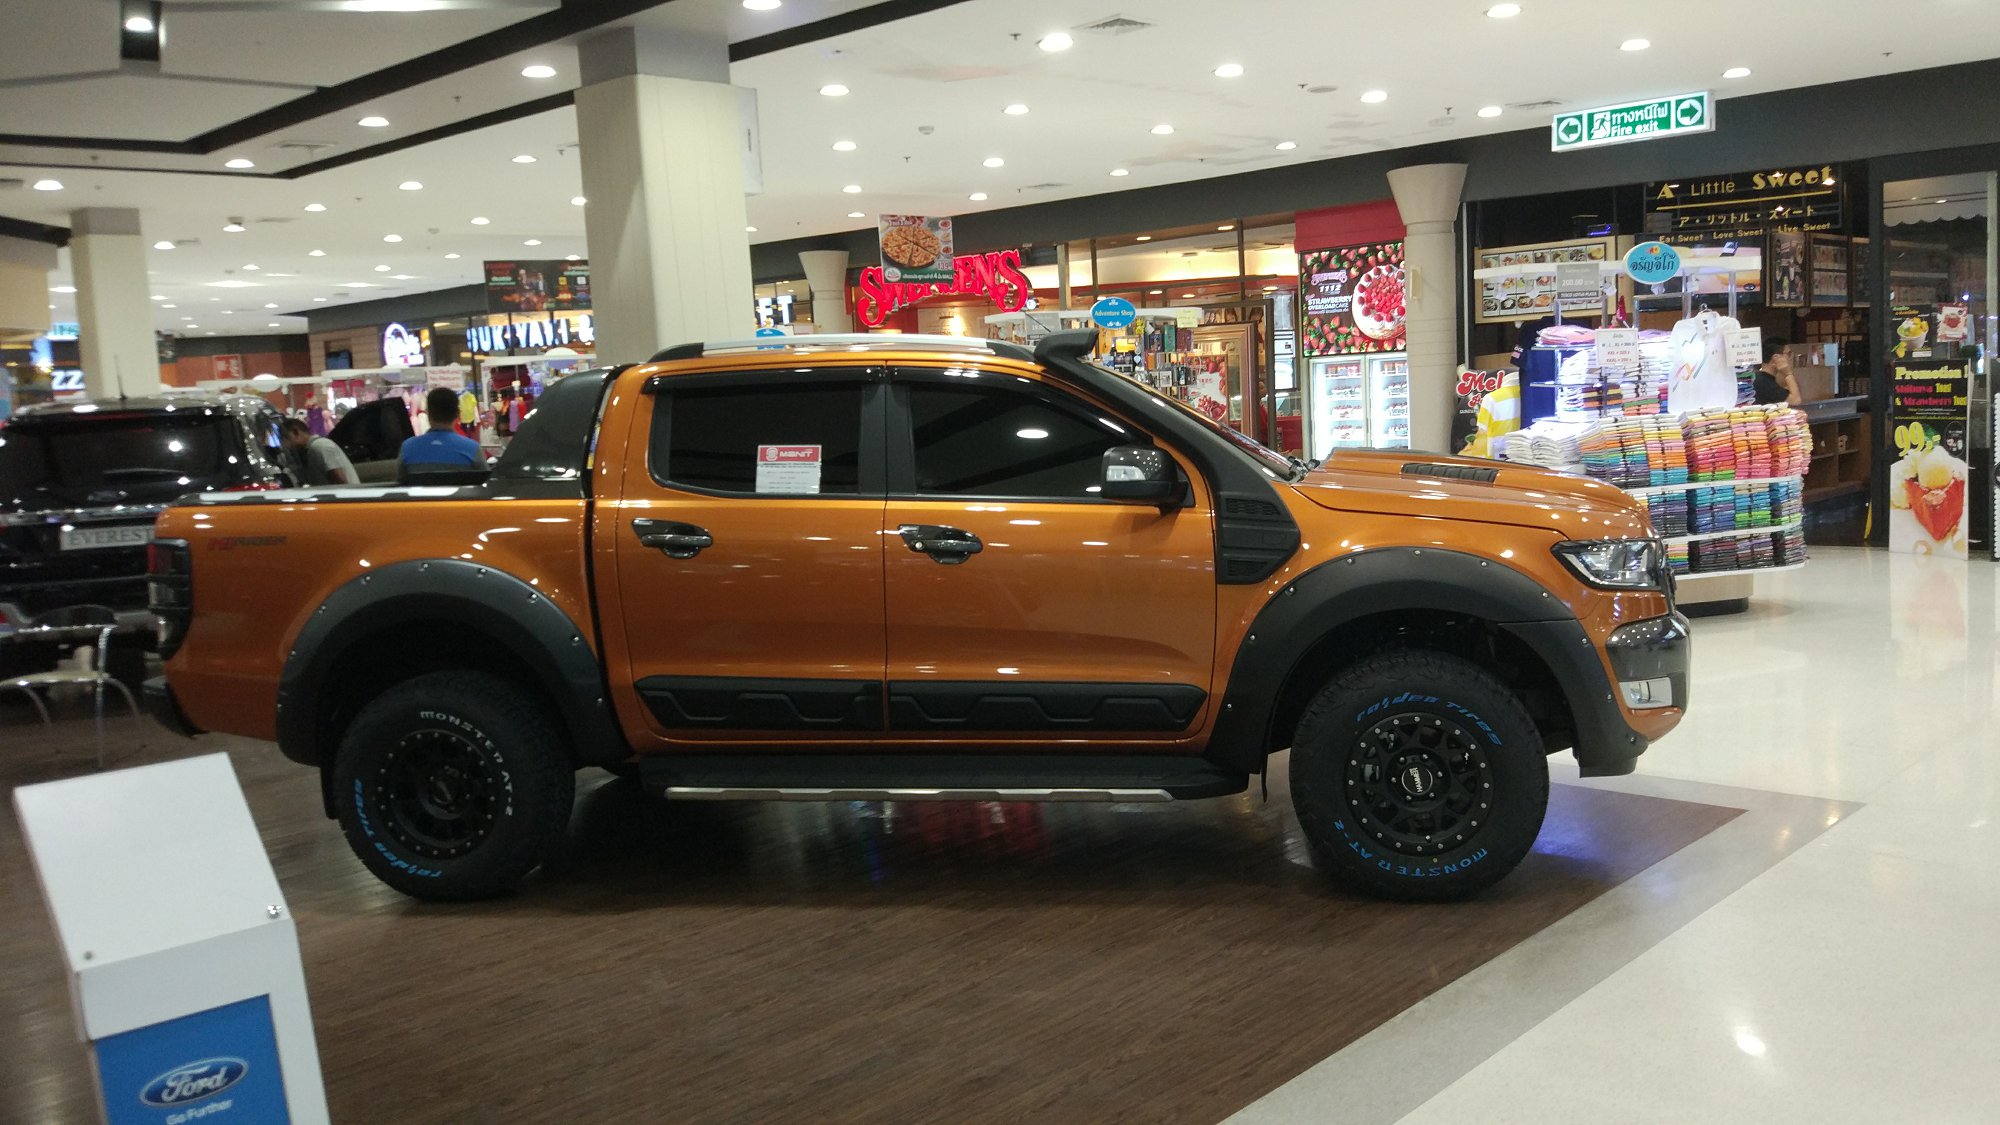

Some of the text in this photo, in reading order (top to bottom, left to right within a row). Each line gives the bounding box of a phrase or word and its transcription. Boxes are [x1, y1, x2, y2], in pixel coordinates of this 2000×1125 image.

[1610, 102, 1669, 125] ทางหนีไฟ
[1610, 120, 1659, 137] Fire exit
[1656, 165, 1833, 200] A Little Sweet
[1658, 221, 1832, 244] Eat Sweet Love Sweet Live Sweet
[1319, 284, 1342, 293] 1112
[1307, 295, 1353, 304] STRAWBERRY
[1094, 309, 1134, 318] Adventure Shop
[1894, 366, 1963, 380] Promotion
[68, 528, 156, 547] EVEREST
[1378, 847, 1488, 877] MONSTER
[161, 1064, 231, 1102] Ford
[165, 1099, 233, 1125] Go Further
